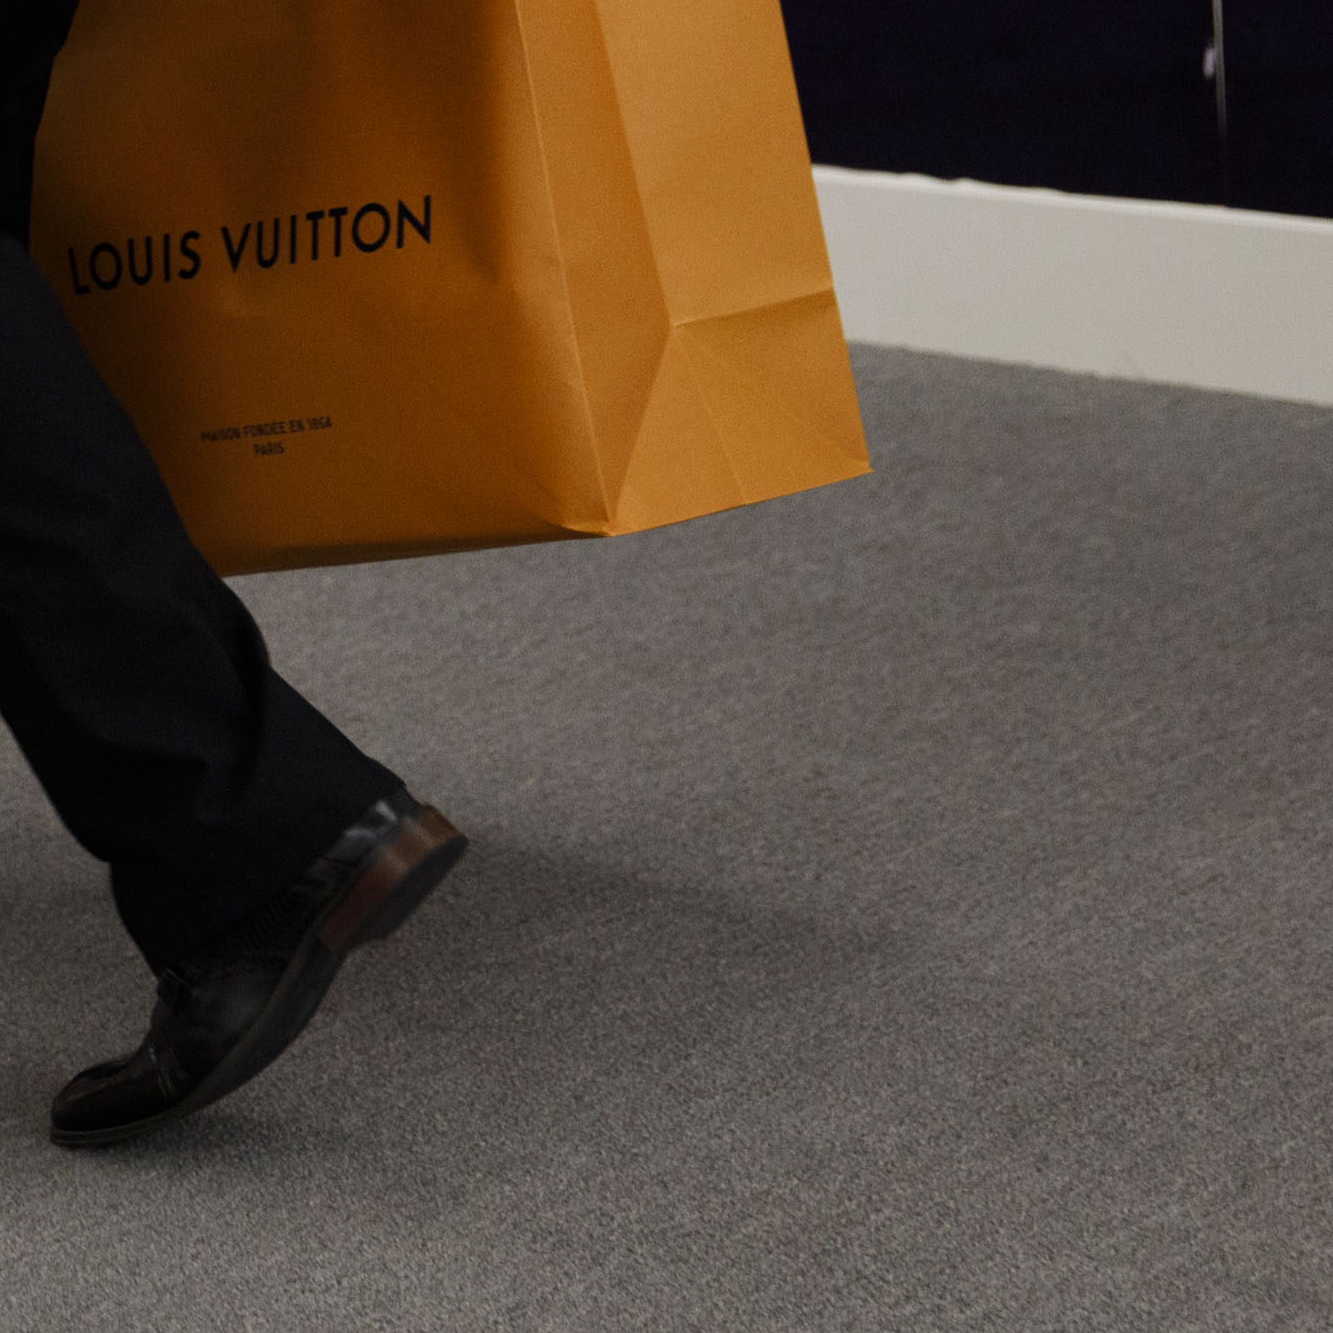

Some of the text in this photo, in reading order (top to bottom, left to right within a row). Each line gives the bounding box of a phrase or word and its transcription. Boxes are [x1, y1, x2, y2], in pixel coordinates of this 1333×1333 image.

[68, 195, 432, 295] LOUIS VUITTON
[253, 441, 285, 456] PARIS
